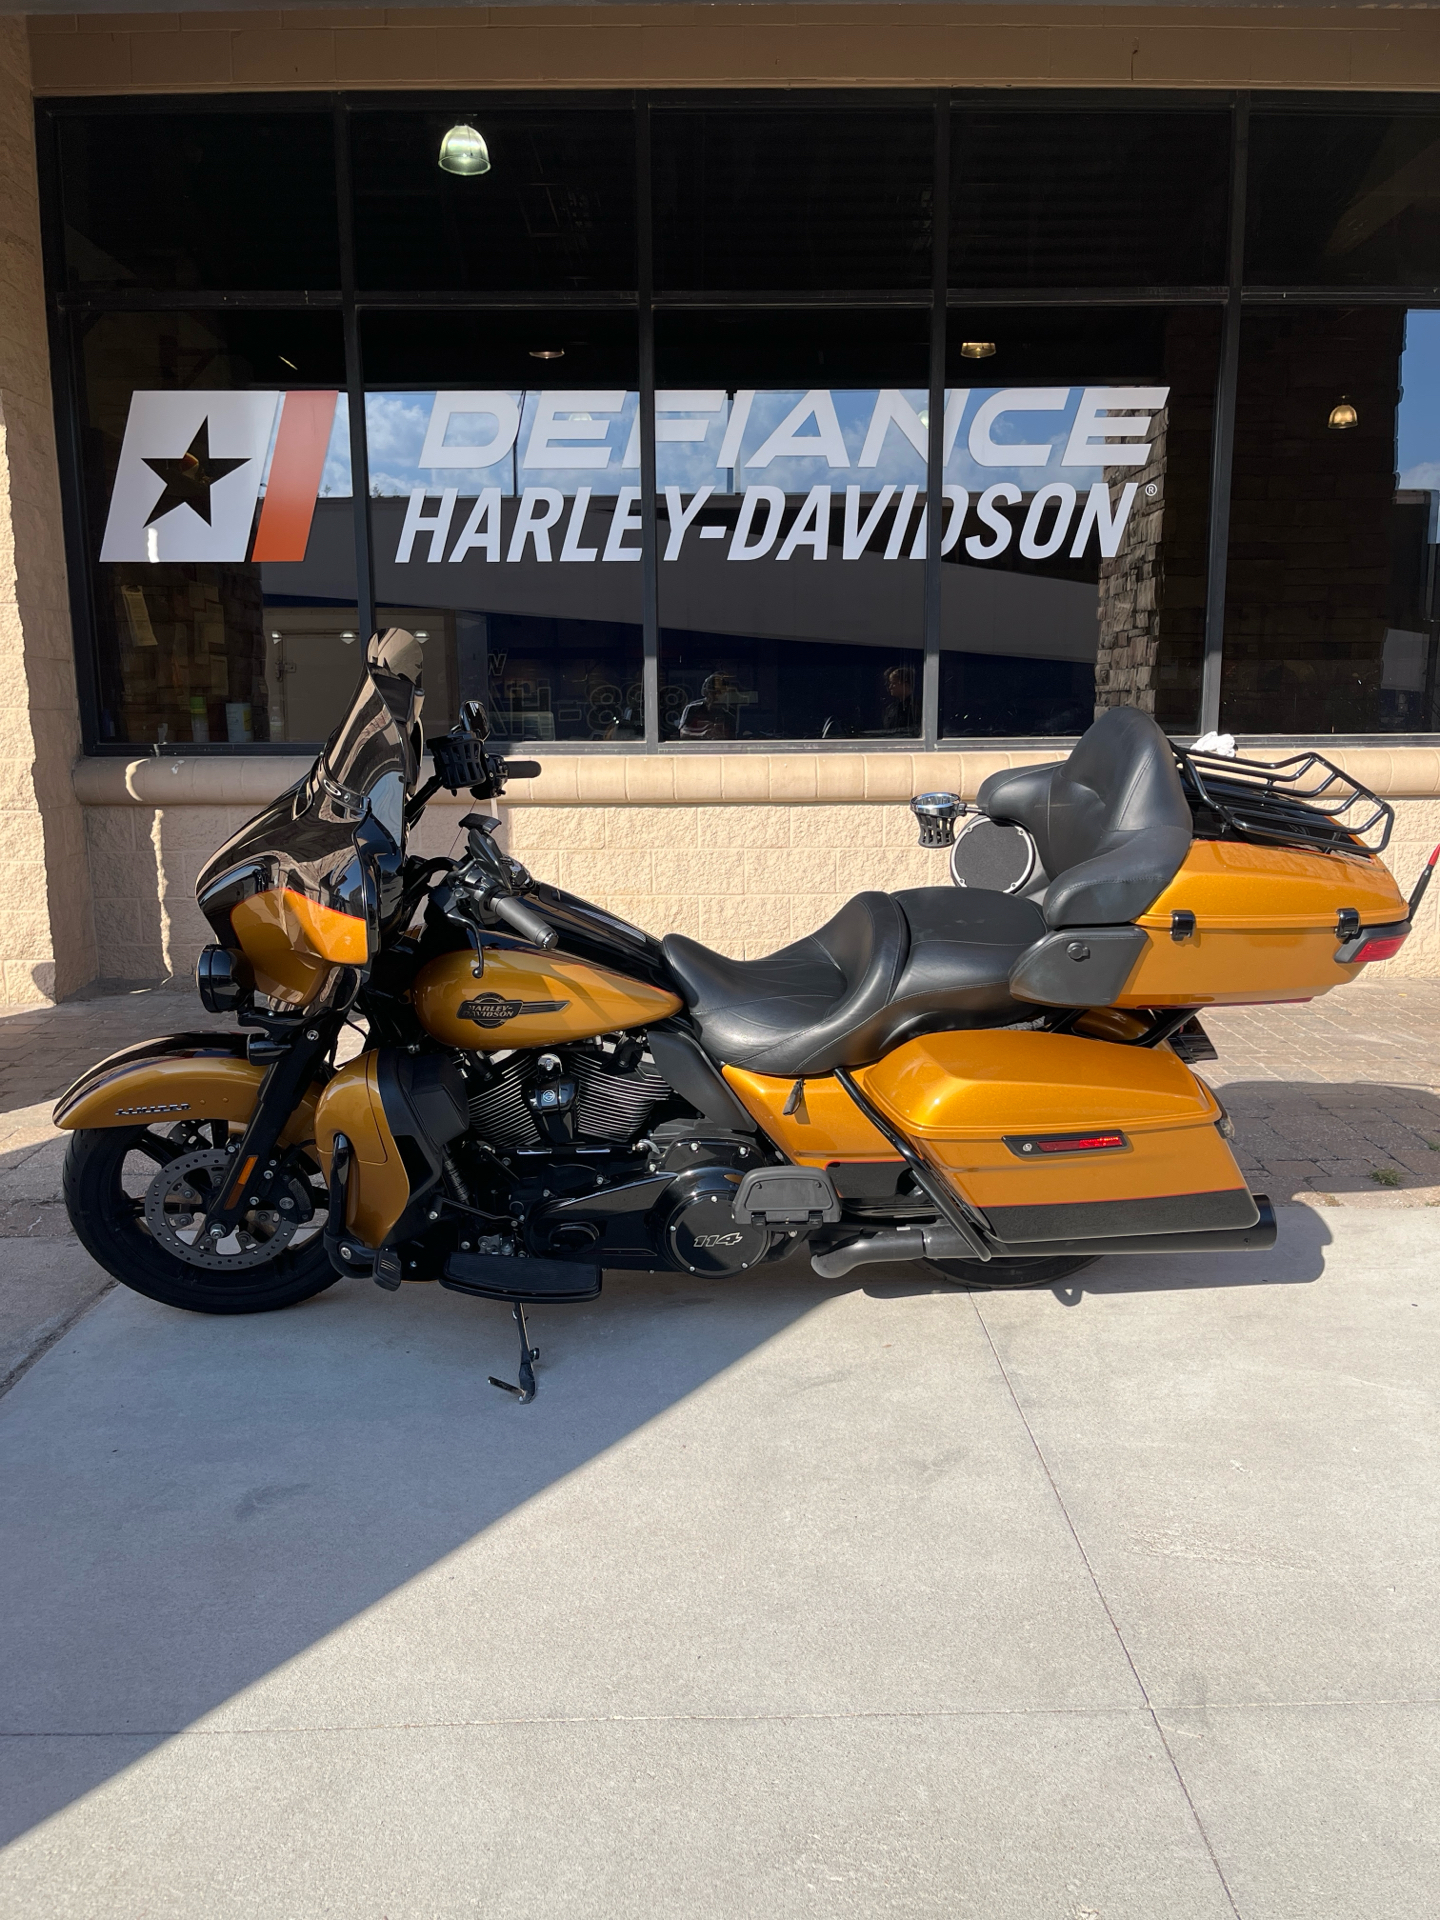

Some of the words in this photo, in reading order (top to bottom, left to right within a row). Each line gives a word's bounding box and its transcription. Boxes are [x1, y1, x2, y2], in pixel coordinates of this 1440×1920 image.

[417, 386, 1170, 469] DEFIANCE
[395, 482, 1140, 564] HARLEY-DAVIDSON
[693, 1232, 743, 1247] 114
